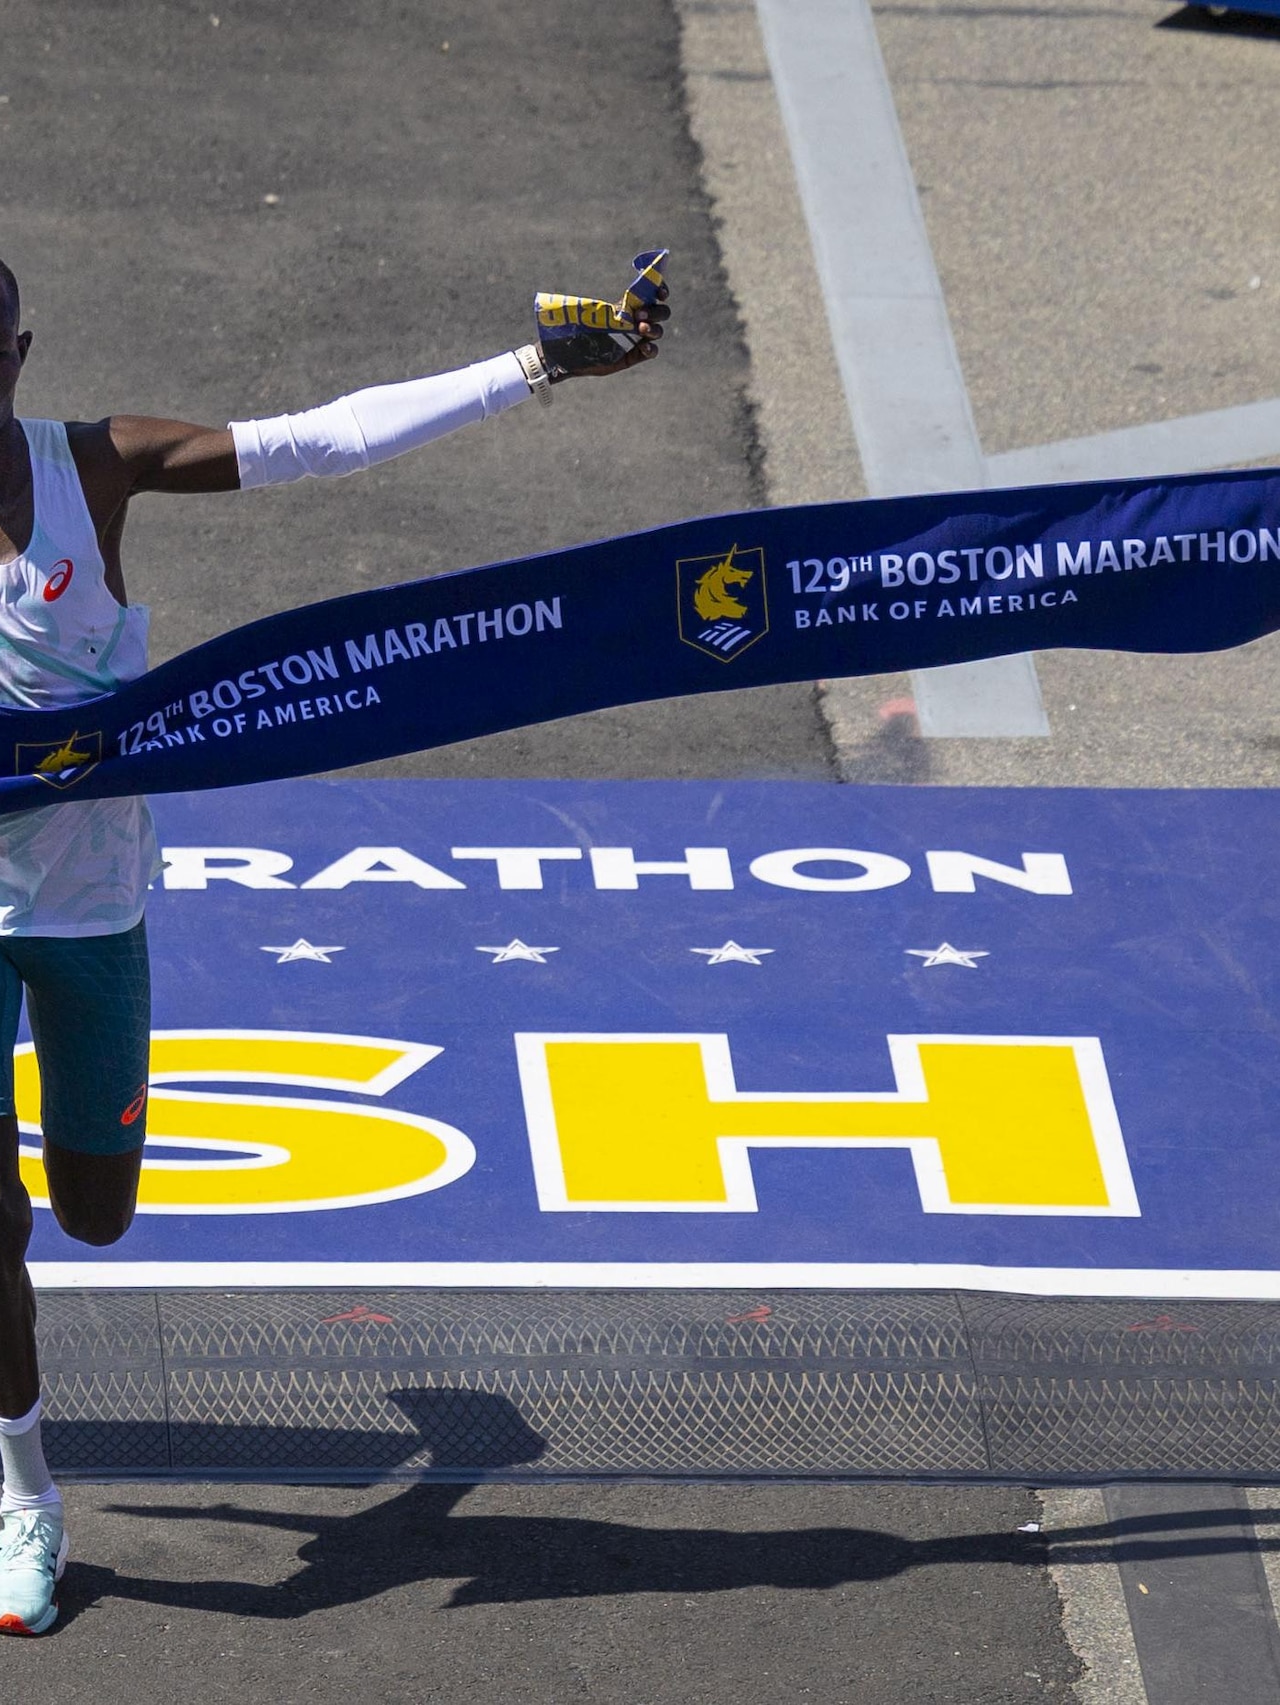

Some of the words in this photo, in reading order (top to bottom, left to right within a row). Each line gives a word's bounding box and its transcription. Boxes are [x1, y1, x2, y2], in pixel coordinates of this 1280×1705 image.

[785, 555, 873, 594] 129TH
[879, 543, 1044, 588] BOSTON
[1056, 527, 1280, 576] MARATHON
[795, 603, 879, 629] BANK
[889, 601, 927, 621] OF
[936, 589, 1078, 617] AMERICA
[189, 646, 340, 719] BOSTON
[344, 596, 563, 673] MARATHON
[211, 712, 247, 738] OF
[256, 685, 381, 730] AMERICA
